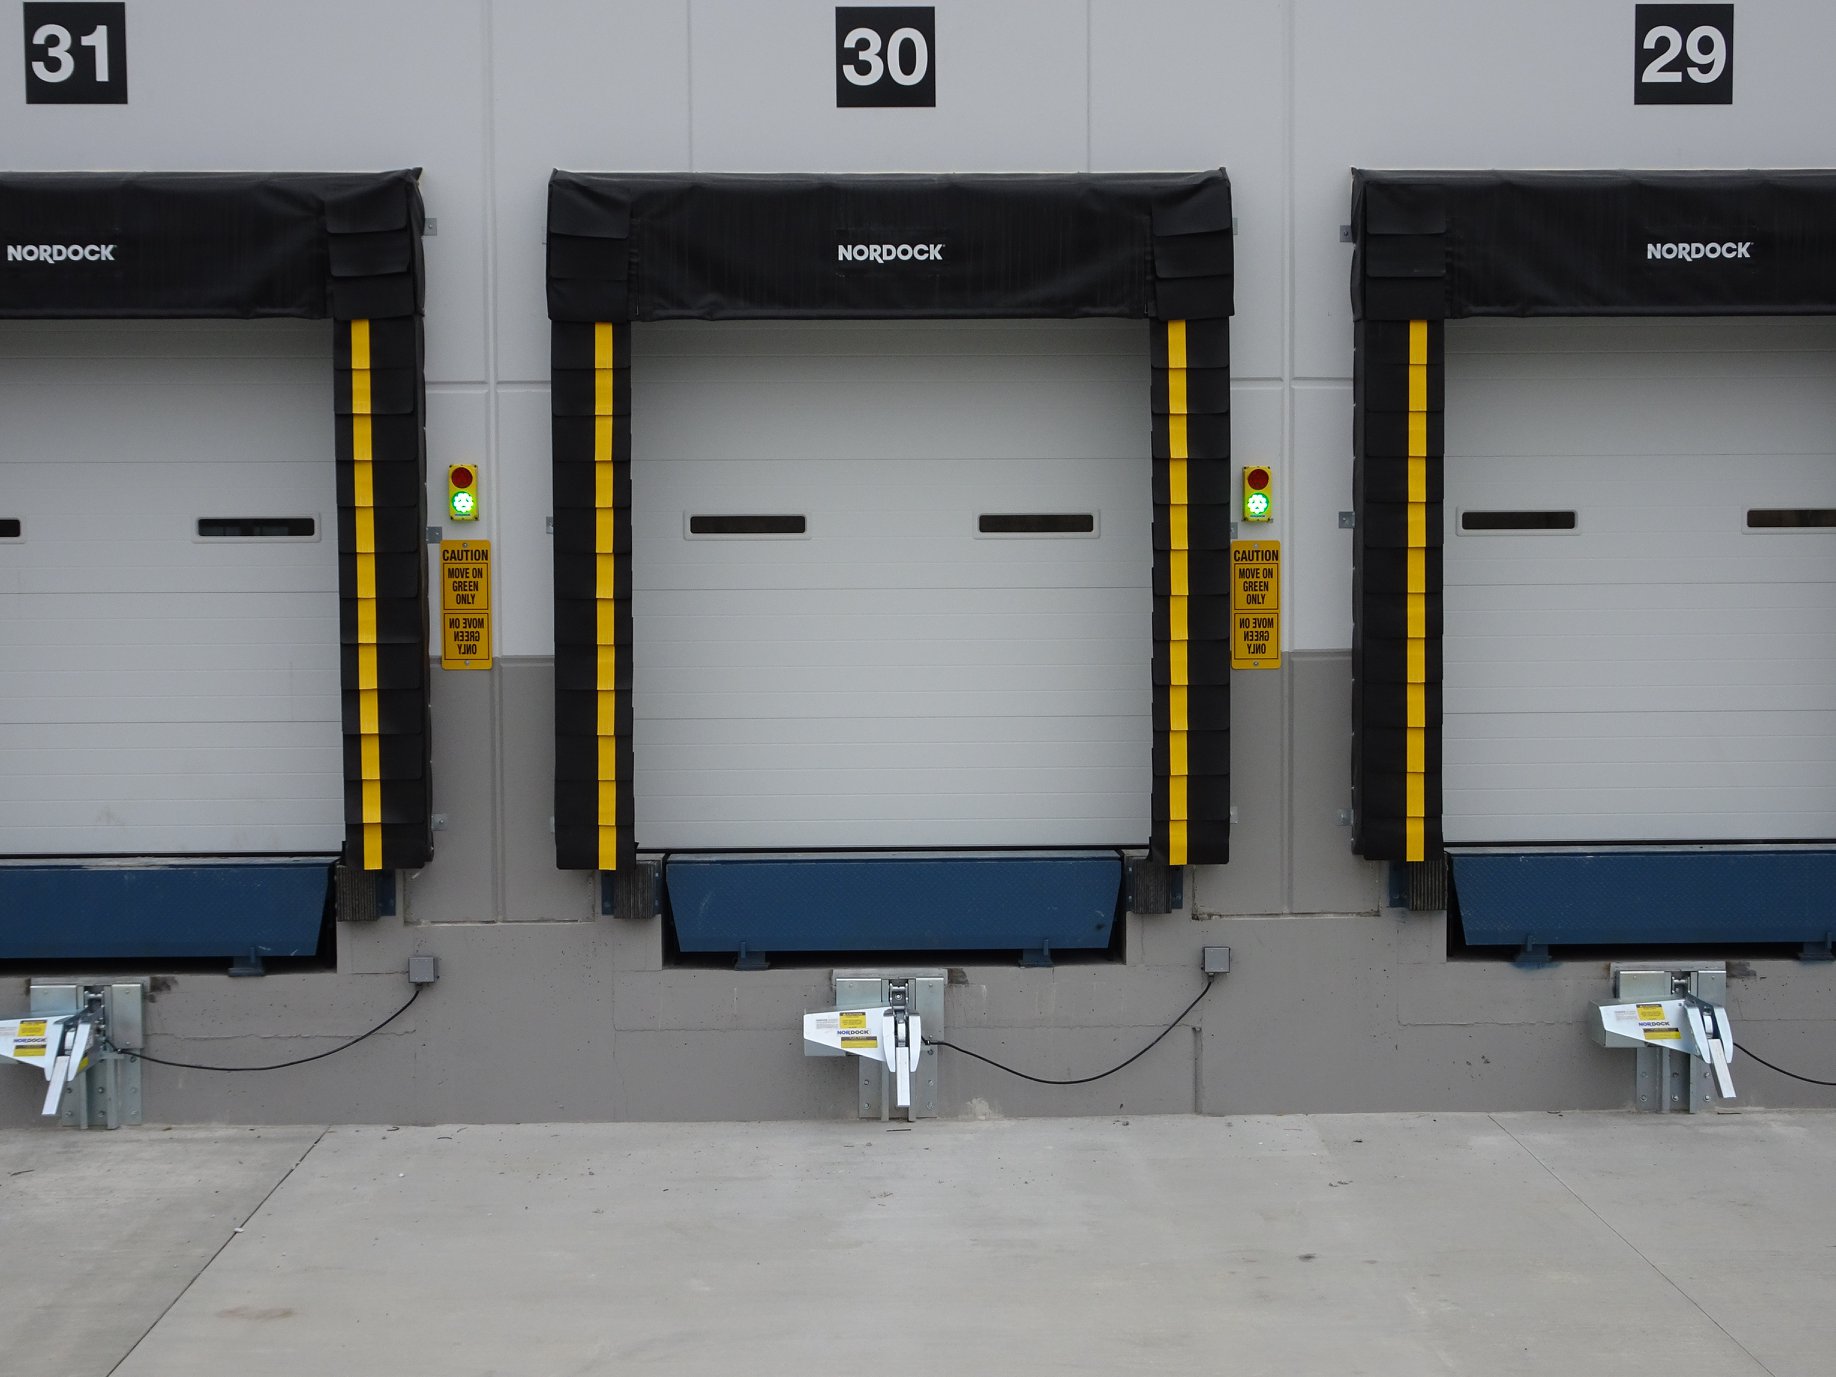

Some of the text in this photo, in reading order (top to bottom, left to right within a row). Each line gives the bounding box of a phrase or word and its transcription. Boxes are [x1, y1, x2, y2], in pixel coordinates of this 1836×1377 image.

[31, 23, 109, 83] 31
[842, 27, 928, 86] 30
[1641, 25, 1727, 84] 29
[7, 244, 115, 264] NORDOCK
[838, 244, 943, 263] NORDOCK
[1647, 242, 1751, 261] NORDOCK
[442, 549, 488, 561] CAUTION
[1233, 549, 1279, 562] CAUTION
[447, 568, 483, 579] MOVE ON
[1238, 568, 1273, 579] MOVE ON
[452, 581, 479, 592] GREEN
[1243, 581, 1269, 592] GREEN
[455, 593, 476, 605] ONLY
[1246, 593, 1266, 605] ONLY
